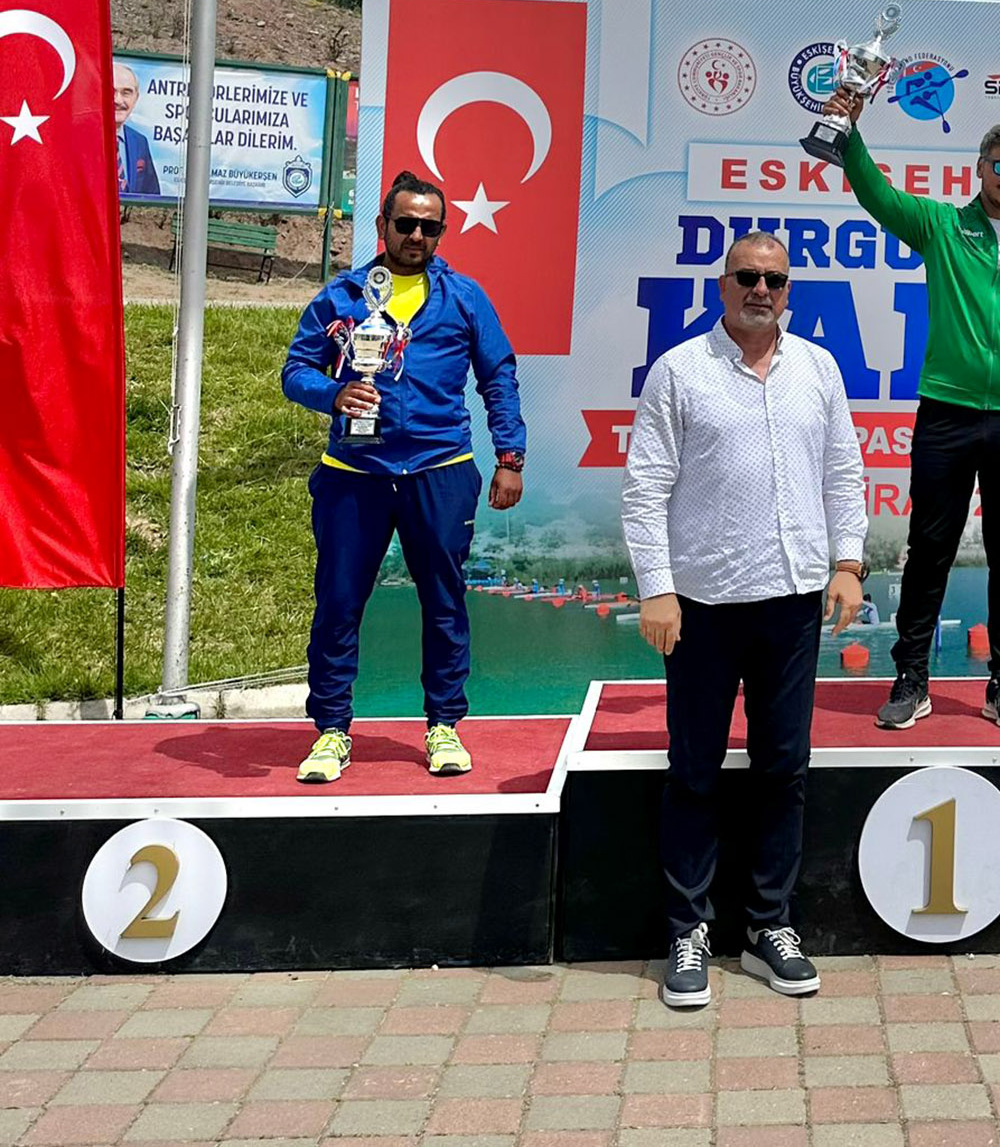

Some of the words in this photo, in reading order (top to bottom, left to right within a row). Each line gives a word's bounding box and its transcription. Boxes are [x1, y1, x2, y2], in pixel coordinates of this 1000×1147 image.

[147, 79, 289, 105] ANTRRLERİMİZE
[292, 92, 309, 108] VE
[165, 103, 289, 128] SPULARIMIZA
[238, 129, 297, 151] DİLERİM.
[229, 167, 278, 181] BÜYÜKERŞEN
[914, 798, 968, 916] 1
[121, 844, 181, 939] 2
